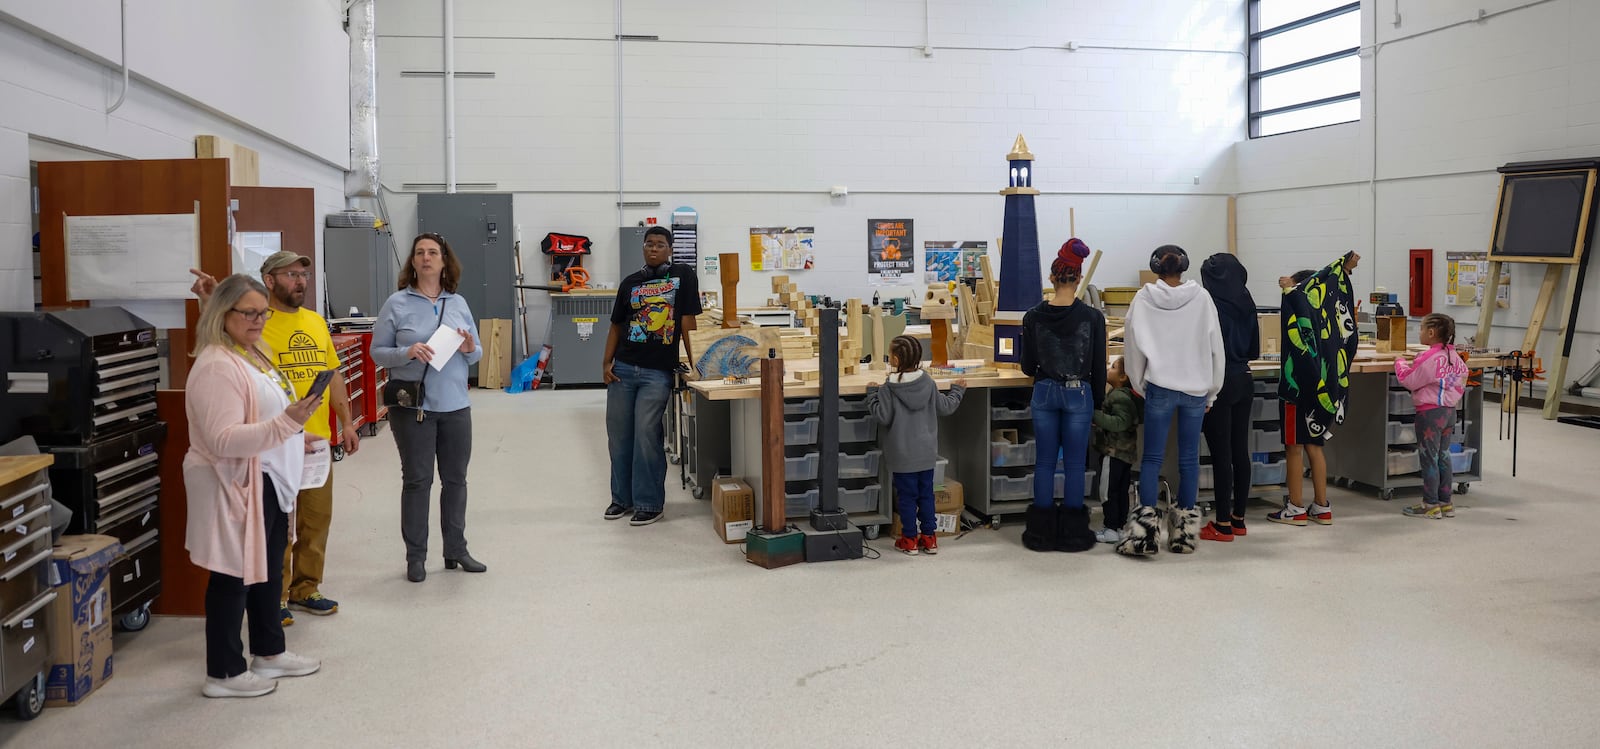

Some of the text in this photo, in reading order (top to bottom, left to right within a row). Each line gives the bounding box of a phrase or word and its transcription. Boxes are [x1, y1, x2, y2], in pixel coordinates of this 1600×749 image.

[875, 229, 907, 237] IMPORTANT
[283, 368, 320, 380] The Do
[58, 667, 68, 678] 3
